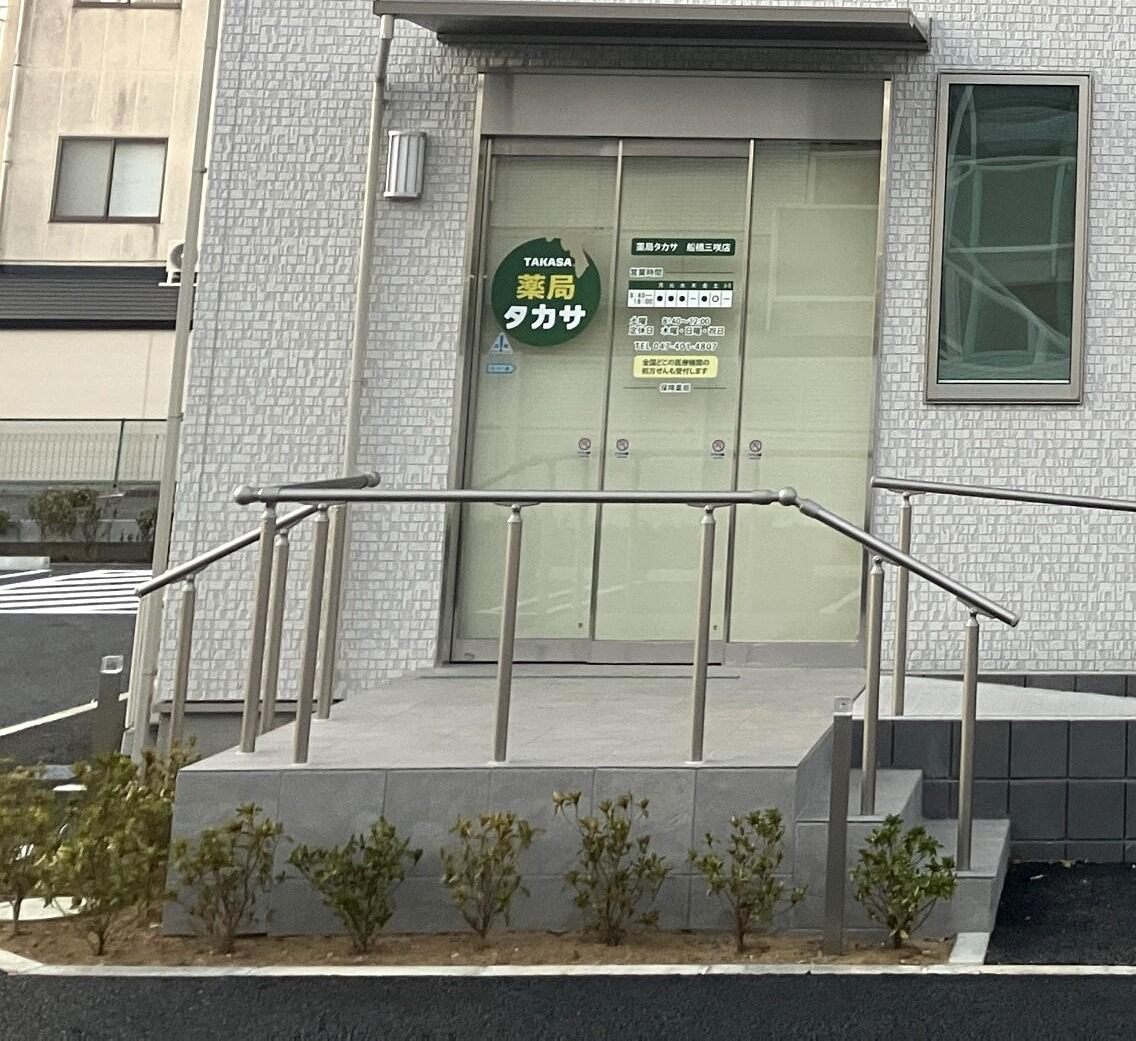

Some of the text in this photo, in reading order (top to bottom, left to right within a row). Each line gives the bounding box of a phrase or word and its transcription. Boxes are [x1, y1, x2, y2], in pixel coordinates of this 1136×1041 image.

[636, 242, 732, 253] 薬局タカサ 船橋三咲店
[523, 257, 572, 267] TAKASA
[516, 274, 576, 301] 薬局
[503, 304, 586, 330] タカサ
[634, 342, 651, 350] TEL
